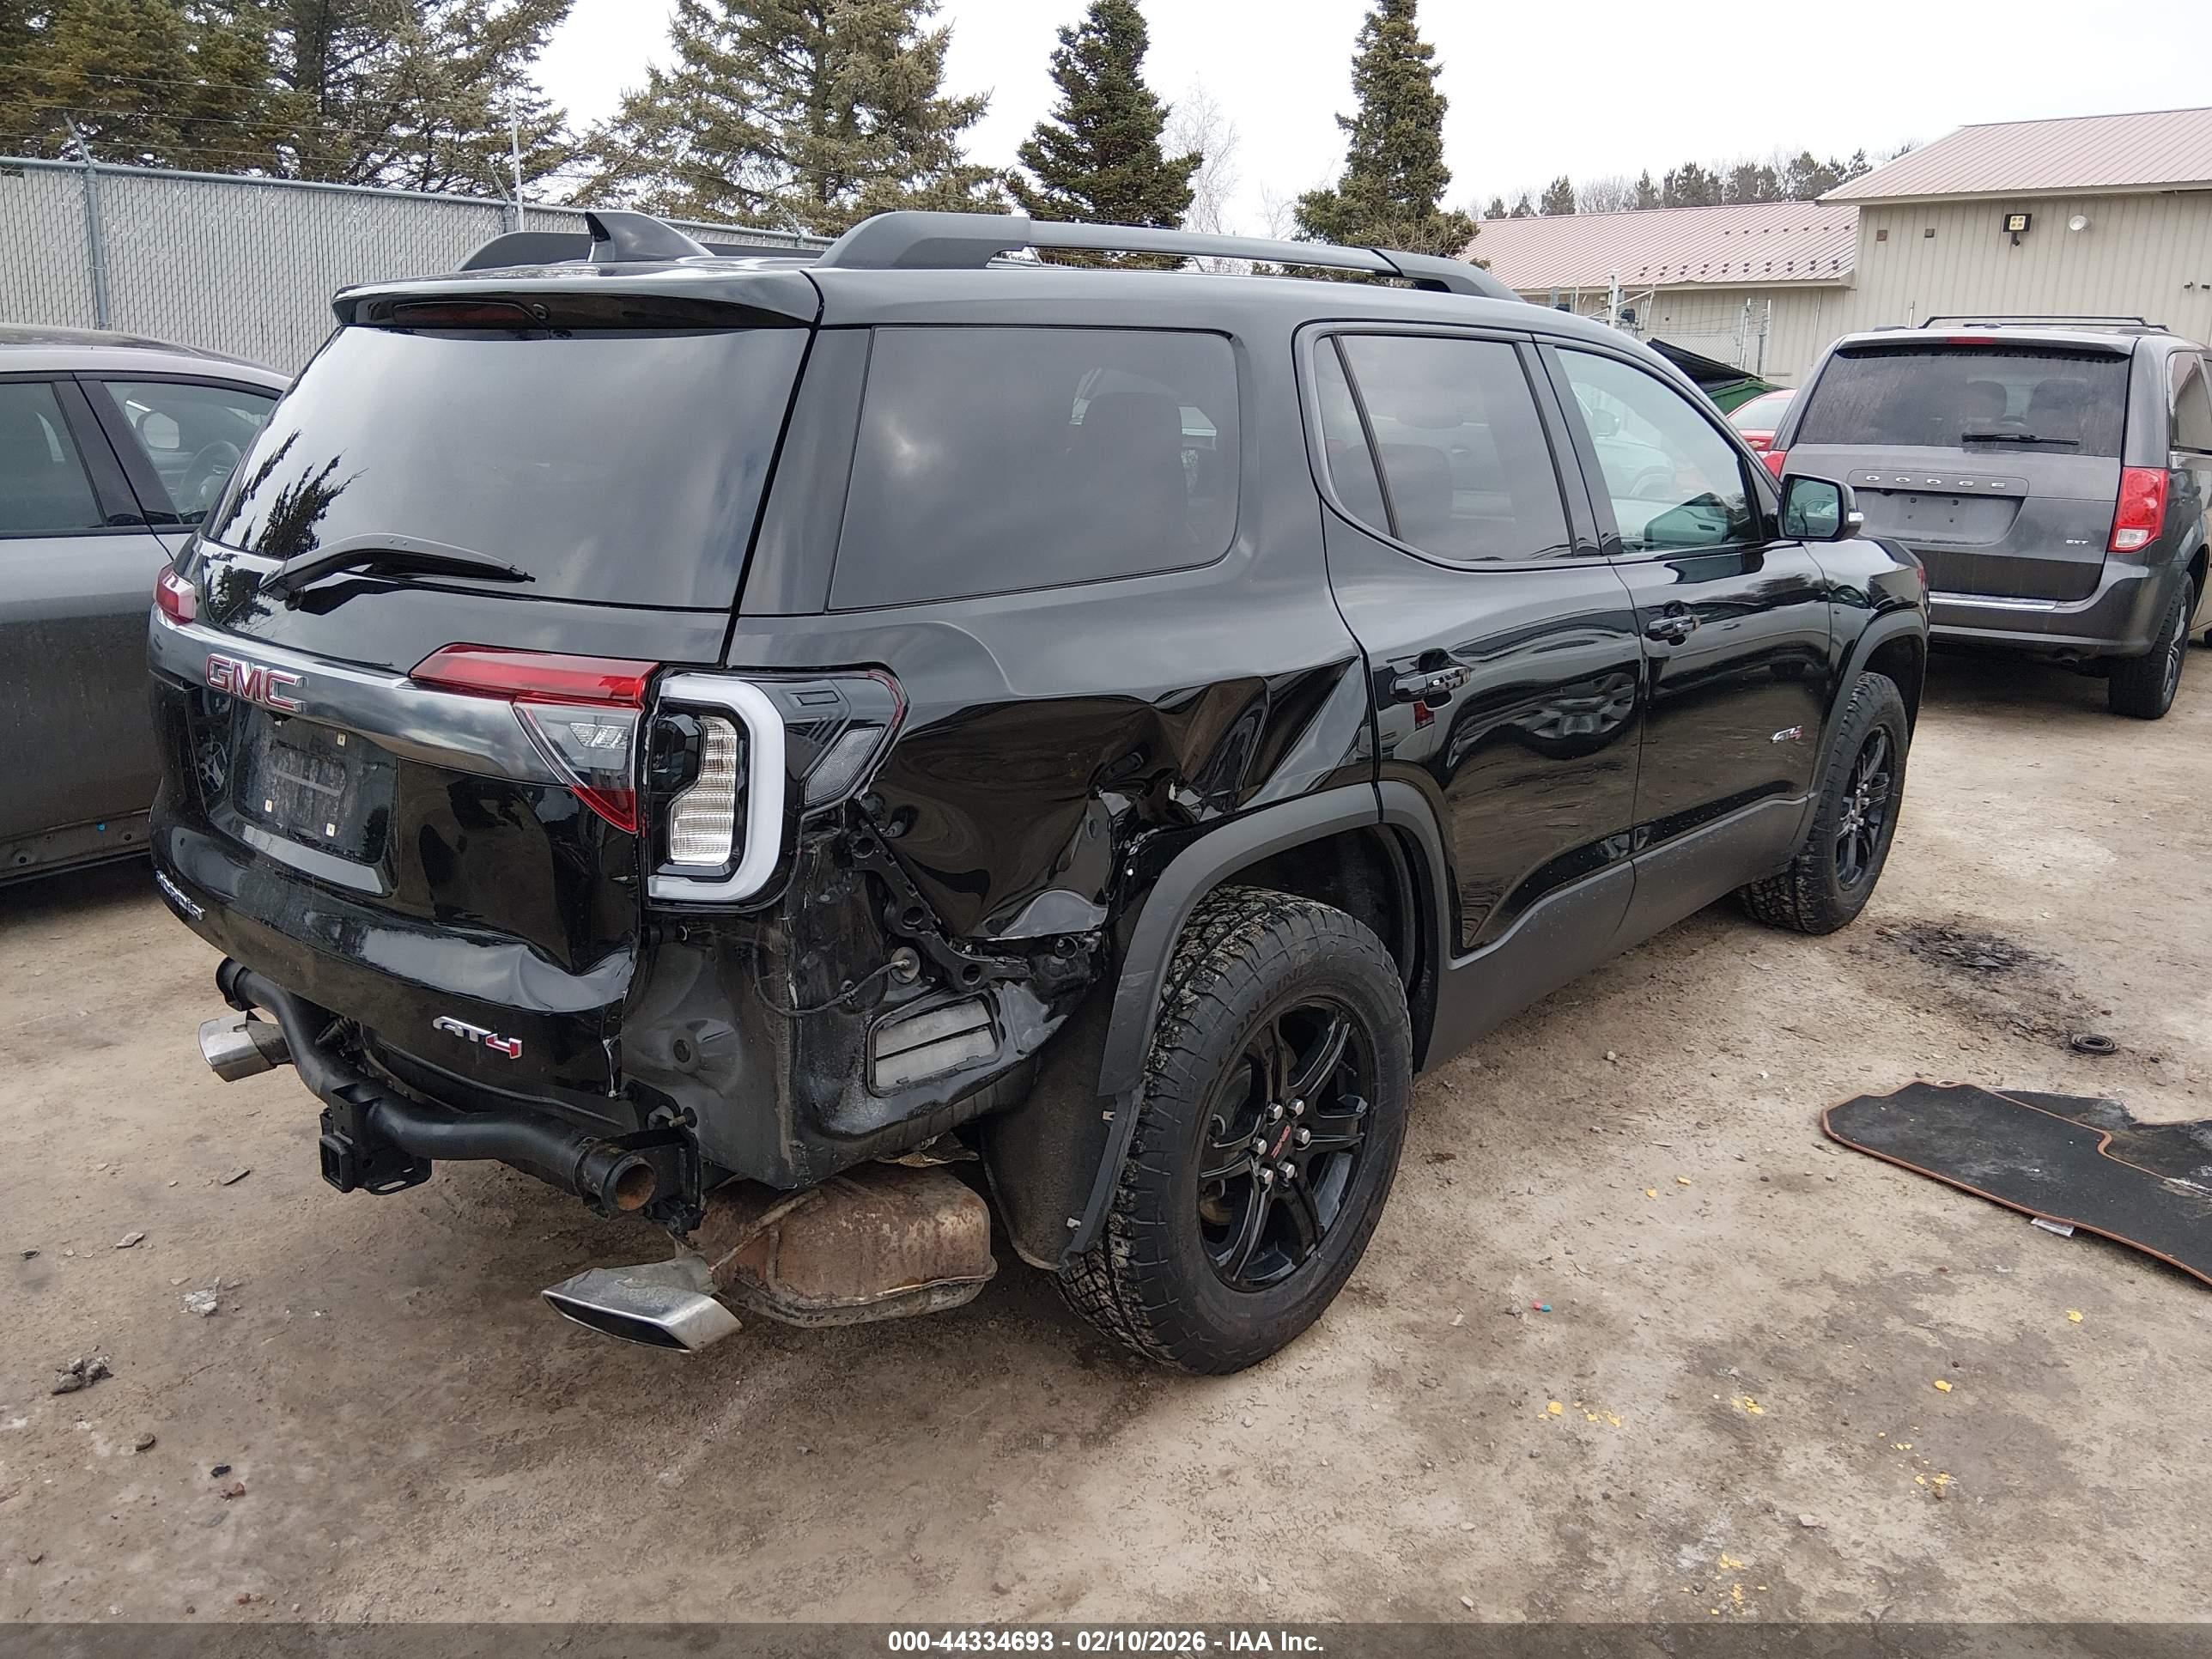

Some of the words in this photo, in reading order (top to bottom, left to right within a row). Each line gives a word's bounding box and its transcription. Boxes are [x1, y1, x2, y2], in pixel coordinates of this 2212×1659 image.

[1865, 475, 2007, 489] DODGE
[206, 653, 307, 714] GMC
[432, 1016, 523, 1060] AT4
